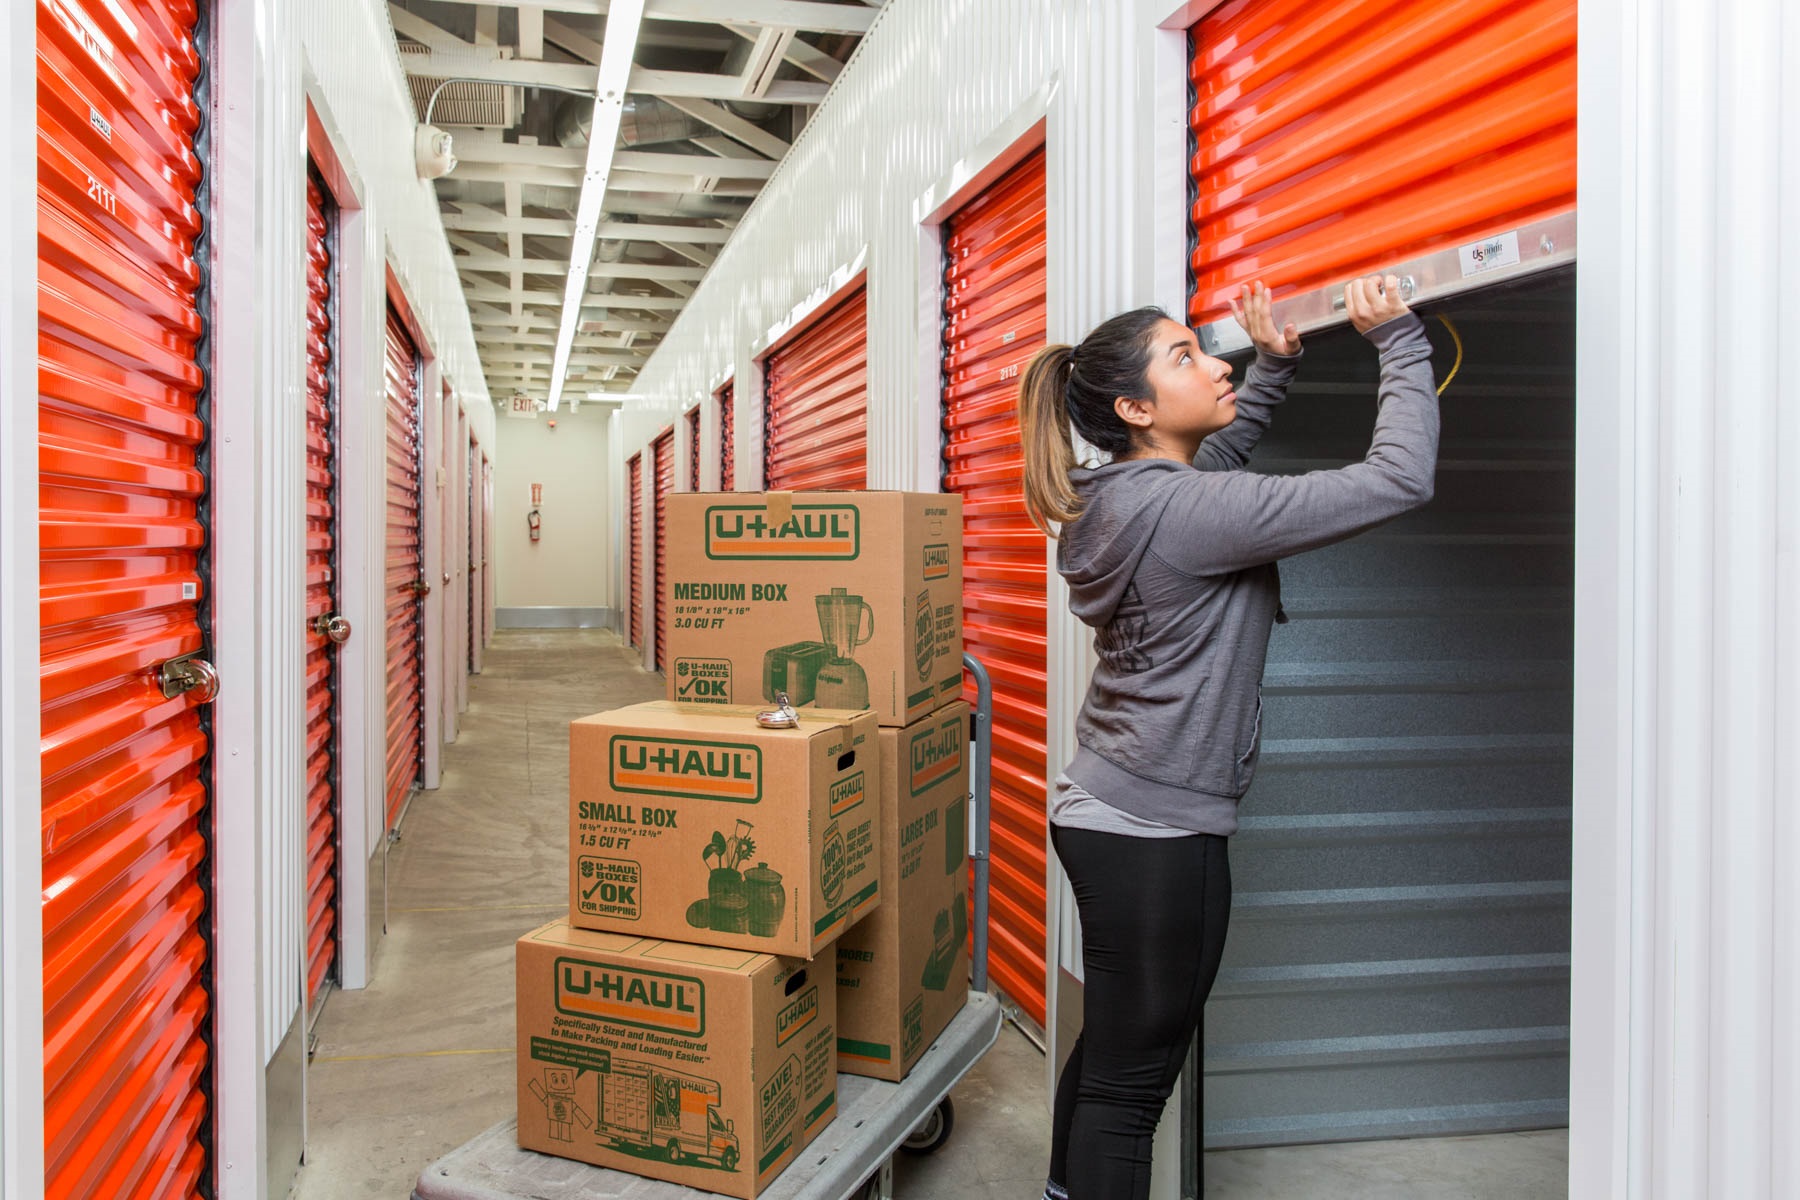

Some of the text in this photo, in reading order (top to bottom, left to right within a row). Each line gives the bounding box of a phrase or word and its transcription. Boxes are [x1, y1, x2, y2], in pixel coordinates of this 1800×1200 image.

[87, 176, 116, 216] 2111
[1001, 364, 1018, 380] 2112
[514, 397, 533, 412] EXIT
[674, 583, 788, 601] MEDIUM BOX
[675, 618, 725, 629] 3.0 CU FT
[691, 663, 728, 671] U-HAUL
[691, 670, 729, 678] BOXES
[695, 680, 728, 697] OK
[620, 745, 752, 779] U-HAUL
[832, 777, 863, 805] U-HAUL
[579, 801, 677, 828] SMALL BOX
[901, 808, 938, 848] LARGE BOX
[580, 834, 631, 850] 1.5 CU FT
[596, 863, 638, 875] U-HAUL
[596, 871, 638, 883] BOXES
[600, 883, 636, 905] OK
[582, 901, 637, 916] FOR SHIPPING
[564, 967, 695, 1013] U-HAUL
[780, 993, 816, 1032] U-HAUL
[553, 1016, 708, 1051] Specifically Sized and Manufactured
[551, 1028, 559, 1037] to
[561, 1029, 583, 1041] Make
[585, 1034, 619, 1049] Packing
[621, 1040, 637, 1051] and
[639, 1041, 673, 1060] Loading
[681, 1080, 708, 1094] U-HAUL
[763, 1063, 792, 1108] SAVE!
[764, 1089, 792, 1129] BEST PRICE
